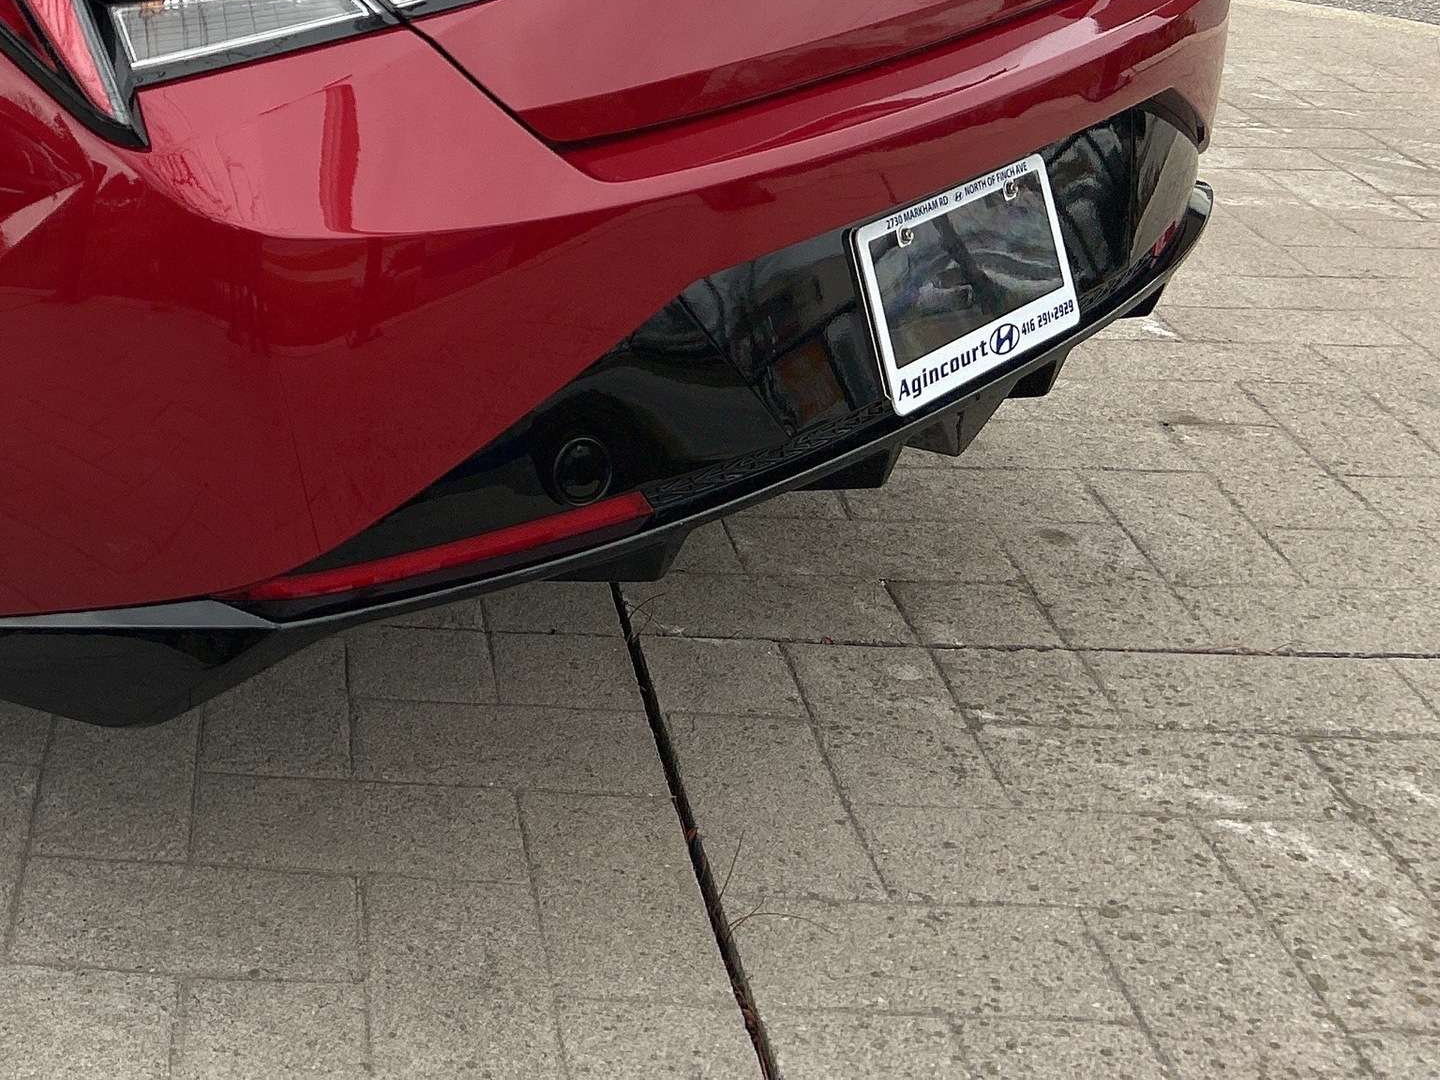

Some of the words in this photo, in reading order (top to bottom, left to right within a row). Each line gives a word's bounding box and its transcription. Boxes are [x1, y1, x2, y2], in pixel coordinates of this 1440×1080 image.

[964, 181, 987, 196] NORTH
[987, 175, 996, 187] OF
[996, 167, 1016, 183] FINCH
[1015, 162, 1028, 175] AVE
[886, 216, 903, 230] 2730
[903, 201, 940, 222] MARKHAM
[939, 195, 949, 207] RD
[898, 339, 989, 401] Agincourt
[1021, 319, 1036, 336] 416
